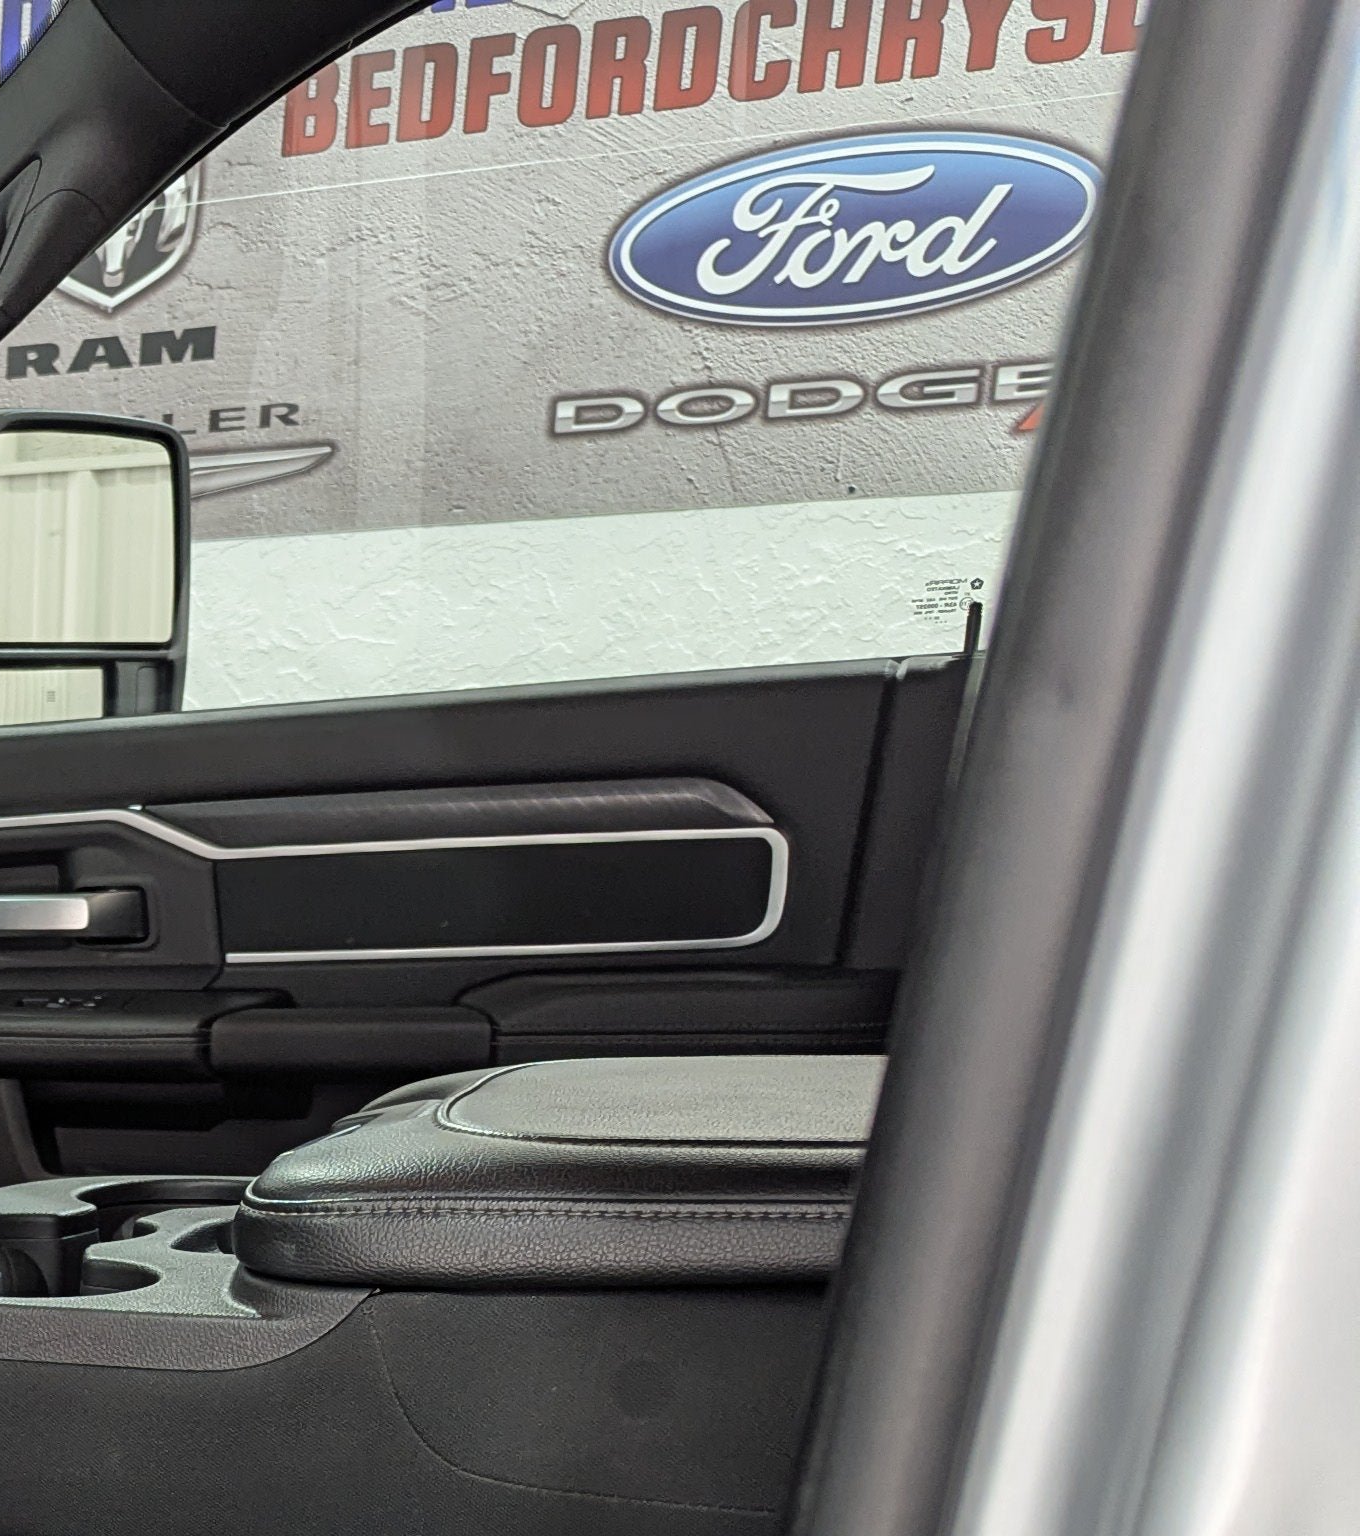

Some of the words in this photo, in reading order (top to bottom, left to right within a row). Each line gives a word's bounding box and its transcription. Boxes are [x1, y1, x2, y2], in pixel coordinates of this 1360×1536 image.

[696, 164, 1013, 296] Ford
[6, 325, 217, 380] RAM
[552, 360, 1055, 435] DODGE
